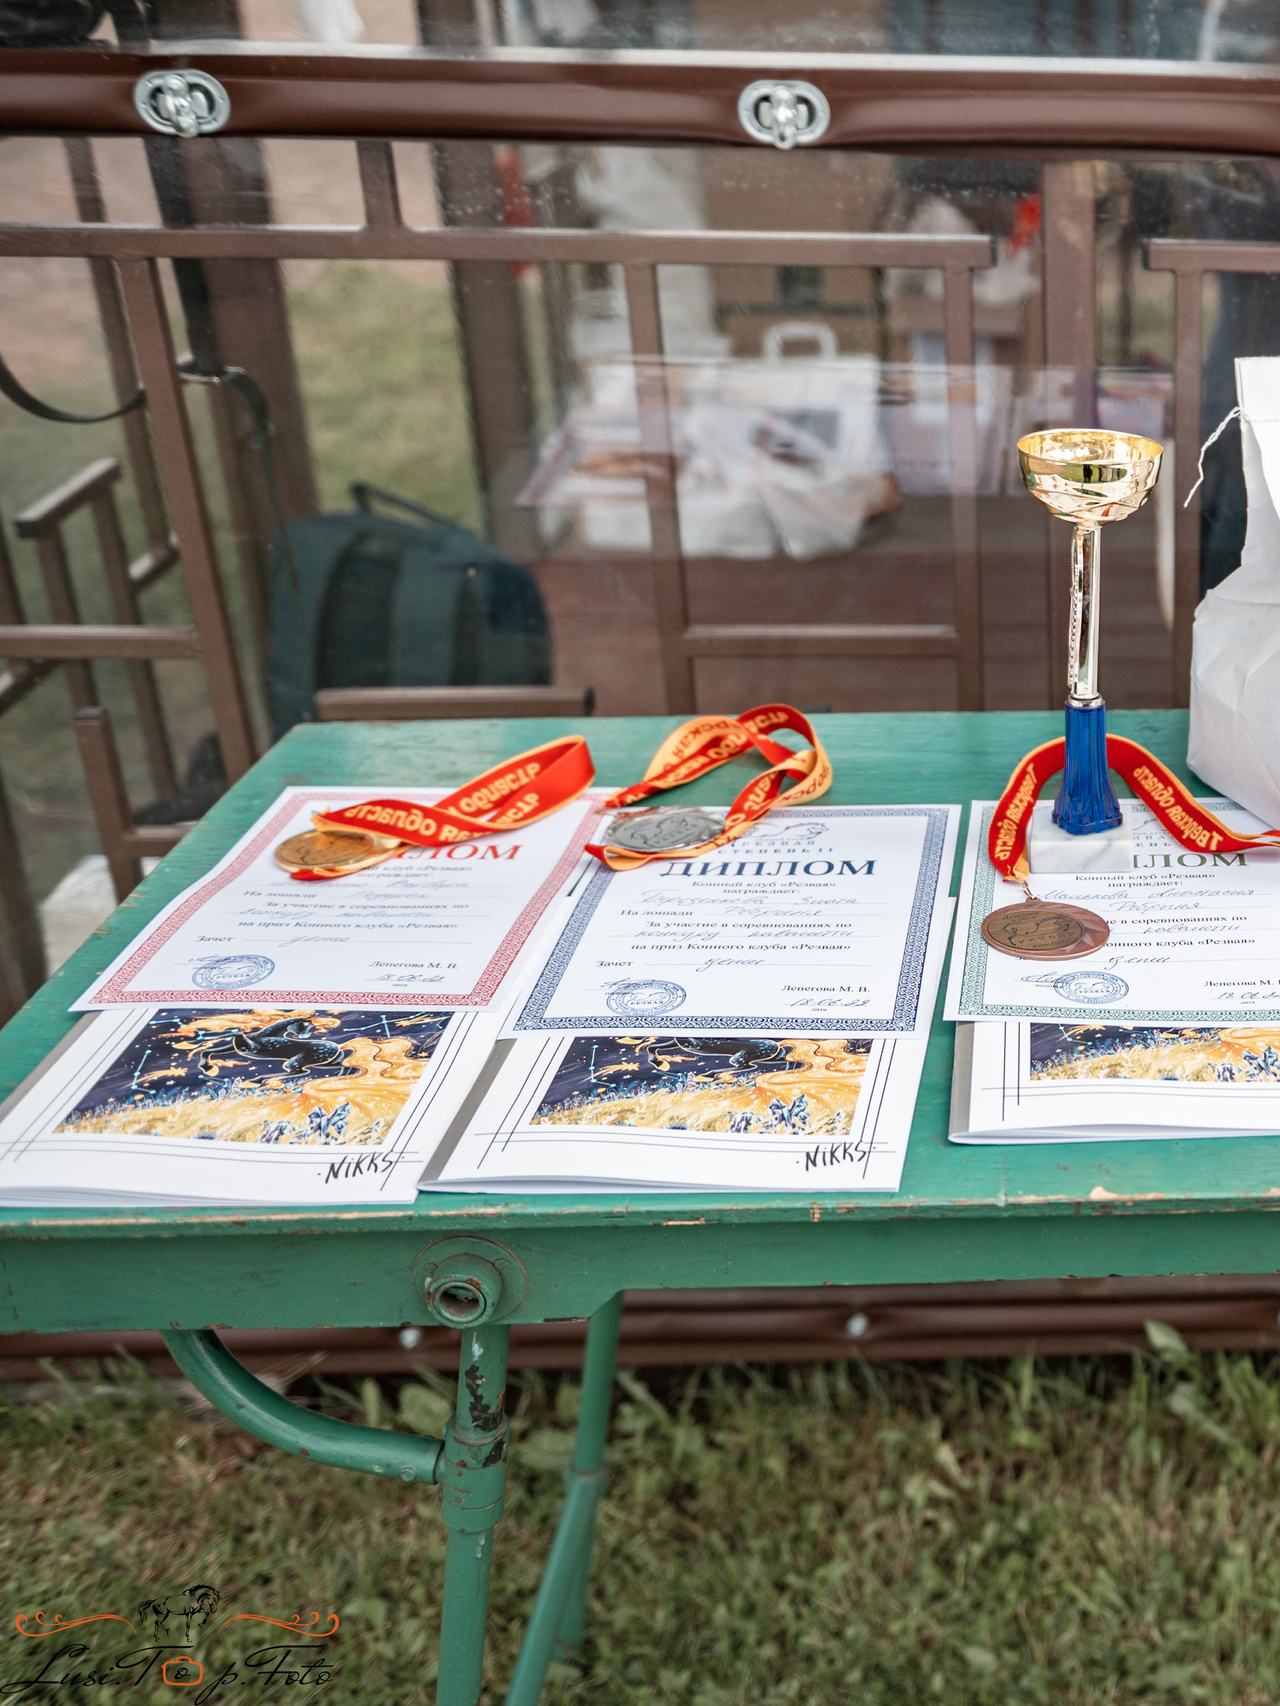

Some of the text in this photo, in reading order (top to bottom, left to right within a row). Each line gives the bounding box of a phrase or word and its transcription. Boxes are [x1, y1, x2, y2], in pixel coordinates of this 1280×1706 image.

[660, 860, 880, 877] ДИПЛОМ
[1131, 917, 1227, 925] соревнованиях
[1156, 940, 1193, 948] клуба
